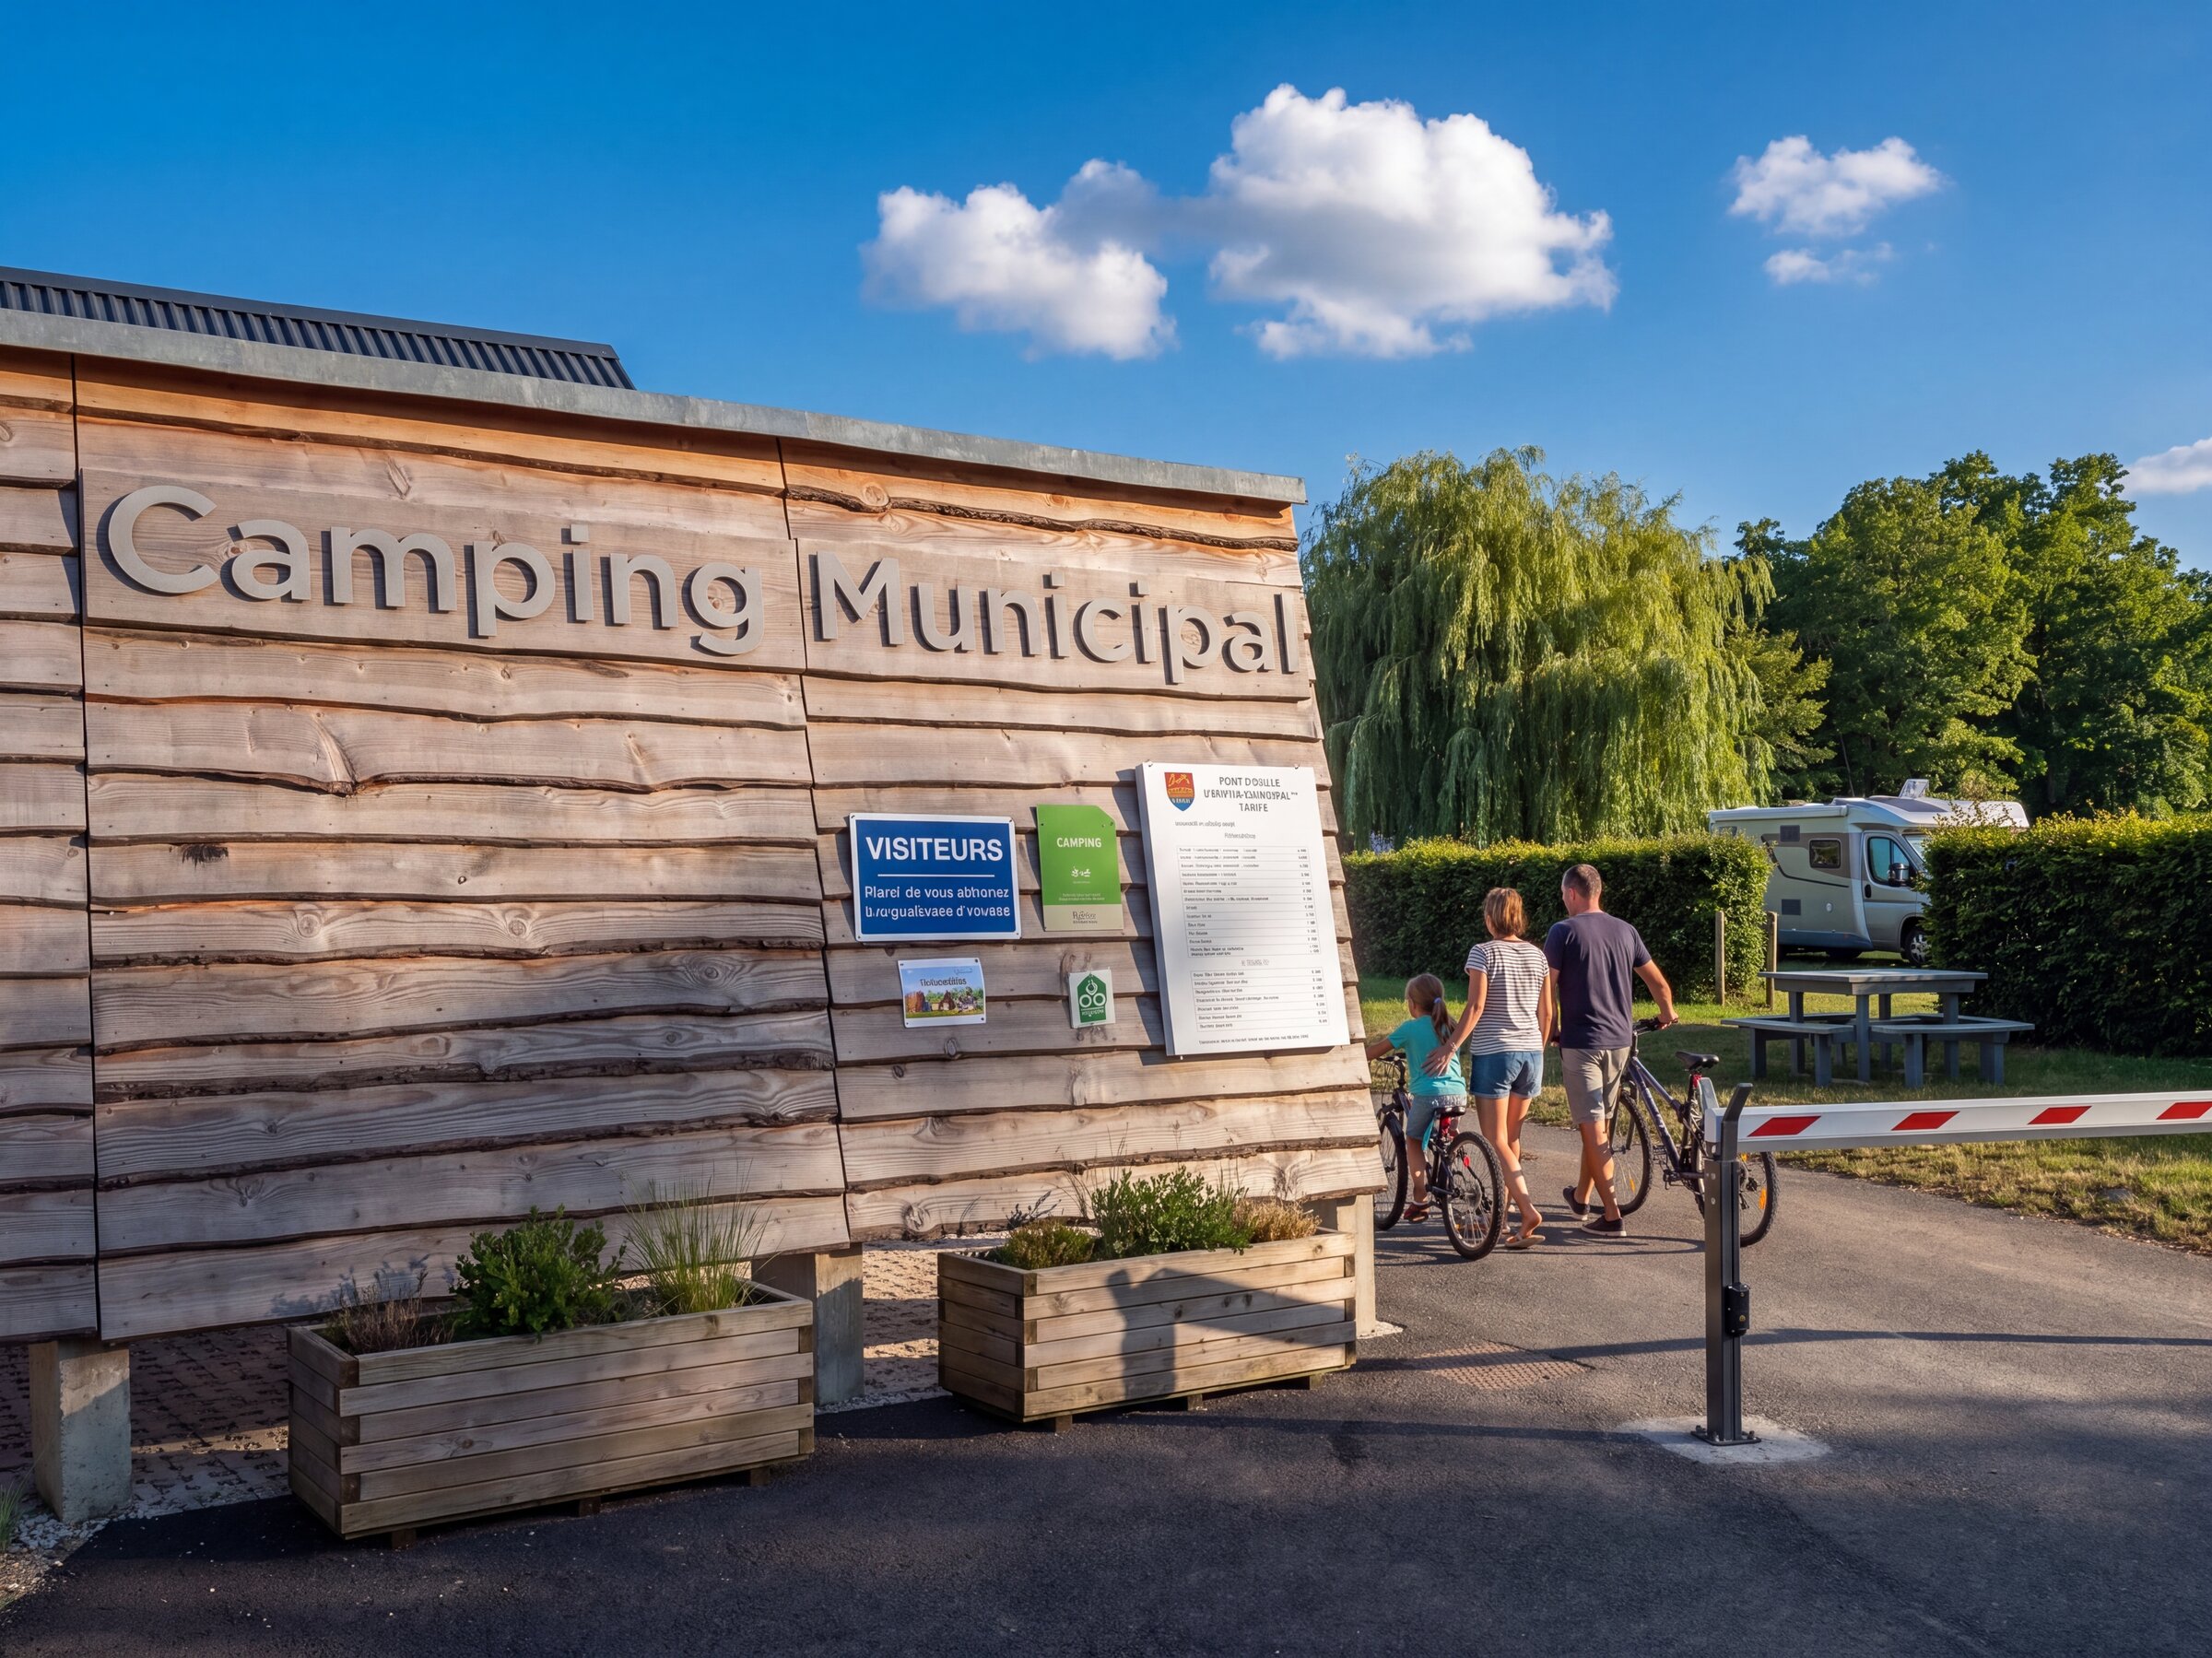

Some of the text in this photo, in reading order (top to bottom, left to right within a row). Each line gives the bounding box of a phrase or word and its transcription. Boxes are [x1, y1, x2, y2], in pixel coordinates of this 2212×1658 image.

[108, 484, 1300, 685] Camping Municipal
[1218, 776, 1243, 786] PONT
[865, 836, 1004, 863] VISITEURS
[1056, 837, 1103, 849] CAMPING
[905, 886, 922, 899] de
[924, 888, 954, 899] vous
